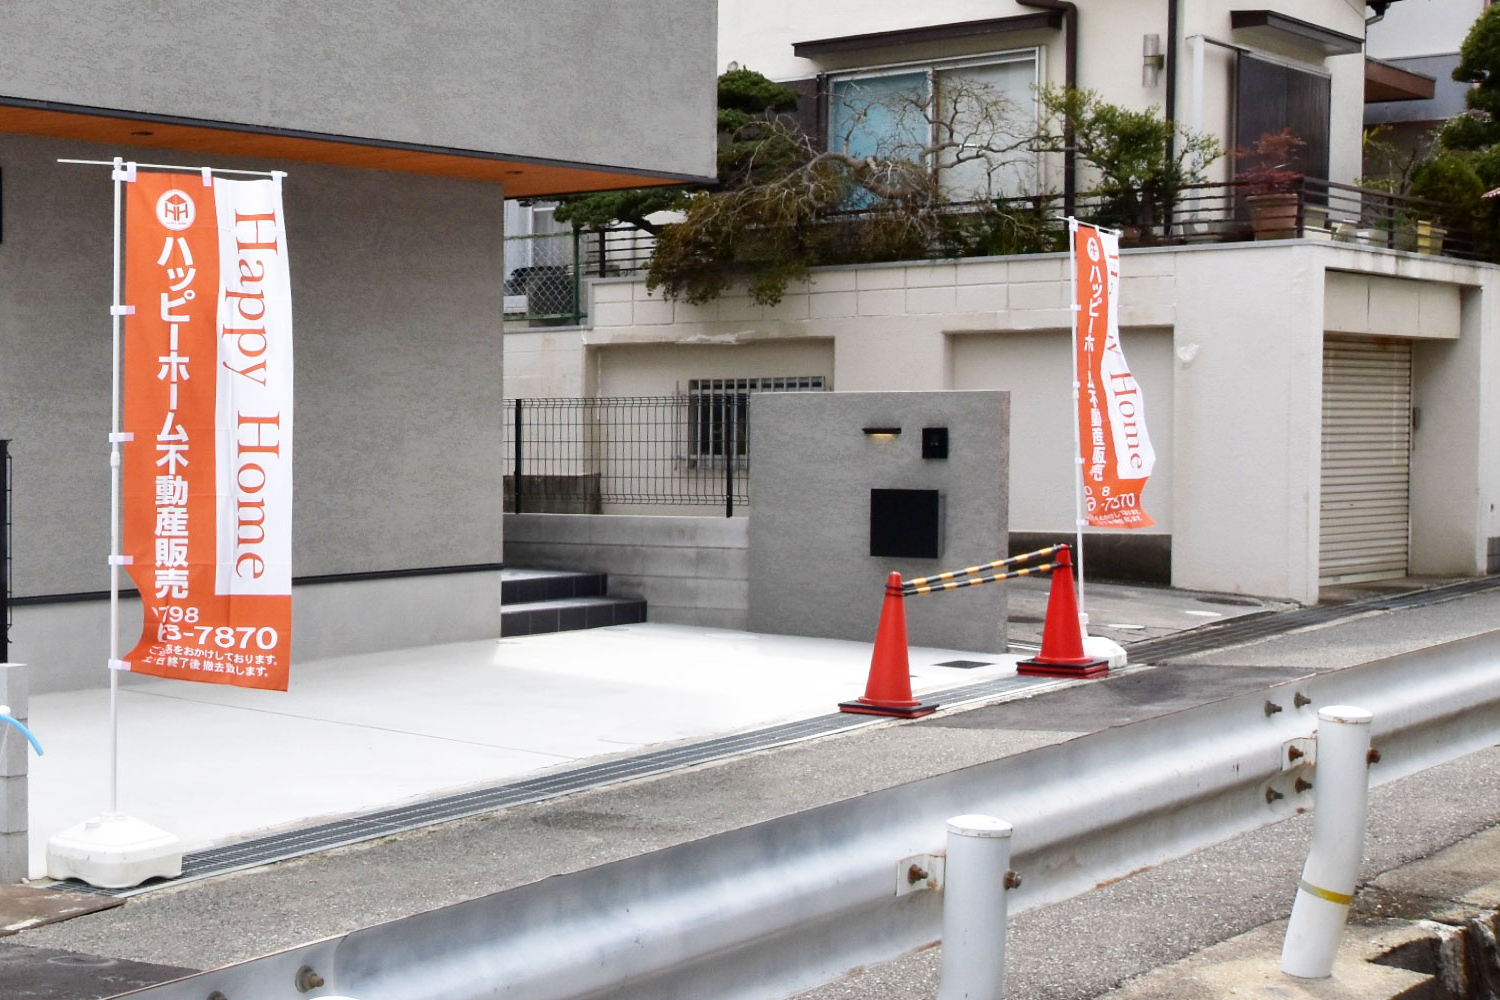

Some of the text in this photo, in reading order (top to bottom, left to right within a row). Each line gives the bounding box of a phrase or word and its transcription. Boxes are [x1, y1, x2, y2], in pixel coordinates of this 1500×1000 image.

[155, 236, 196, 600] ハッピーホーム不動産販売
[222, 208, 280, 580] Happy Home
[1109, 371, 1143, 470] Home
[151, 605, 199, 624] 798
